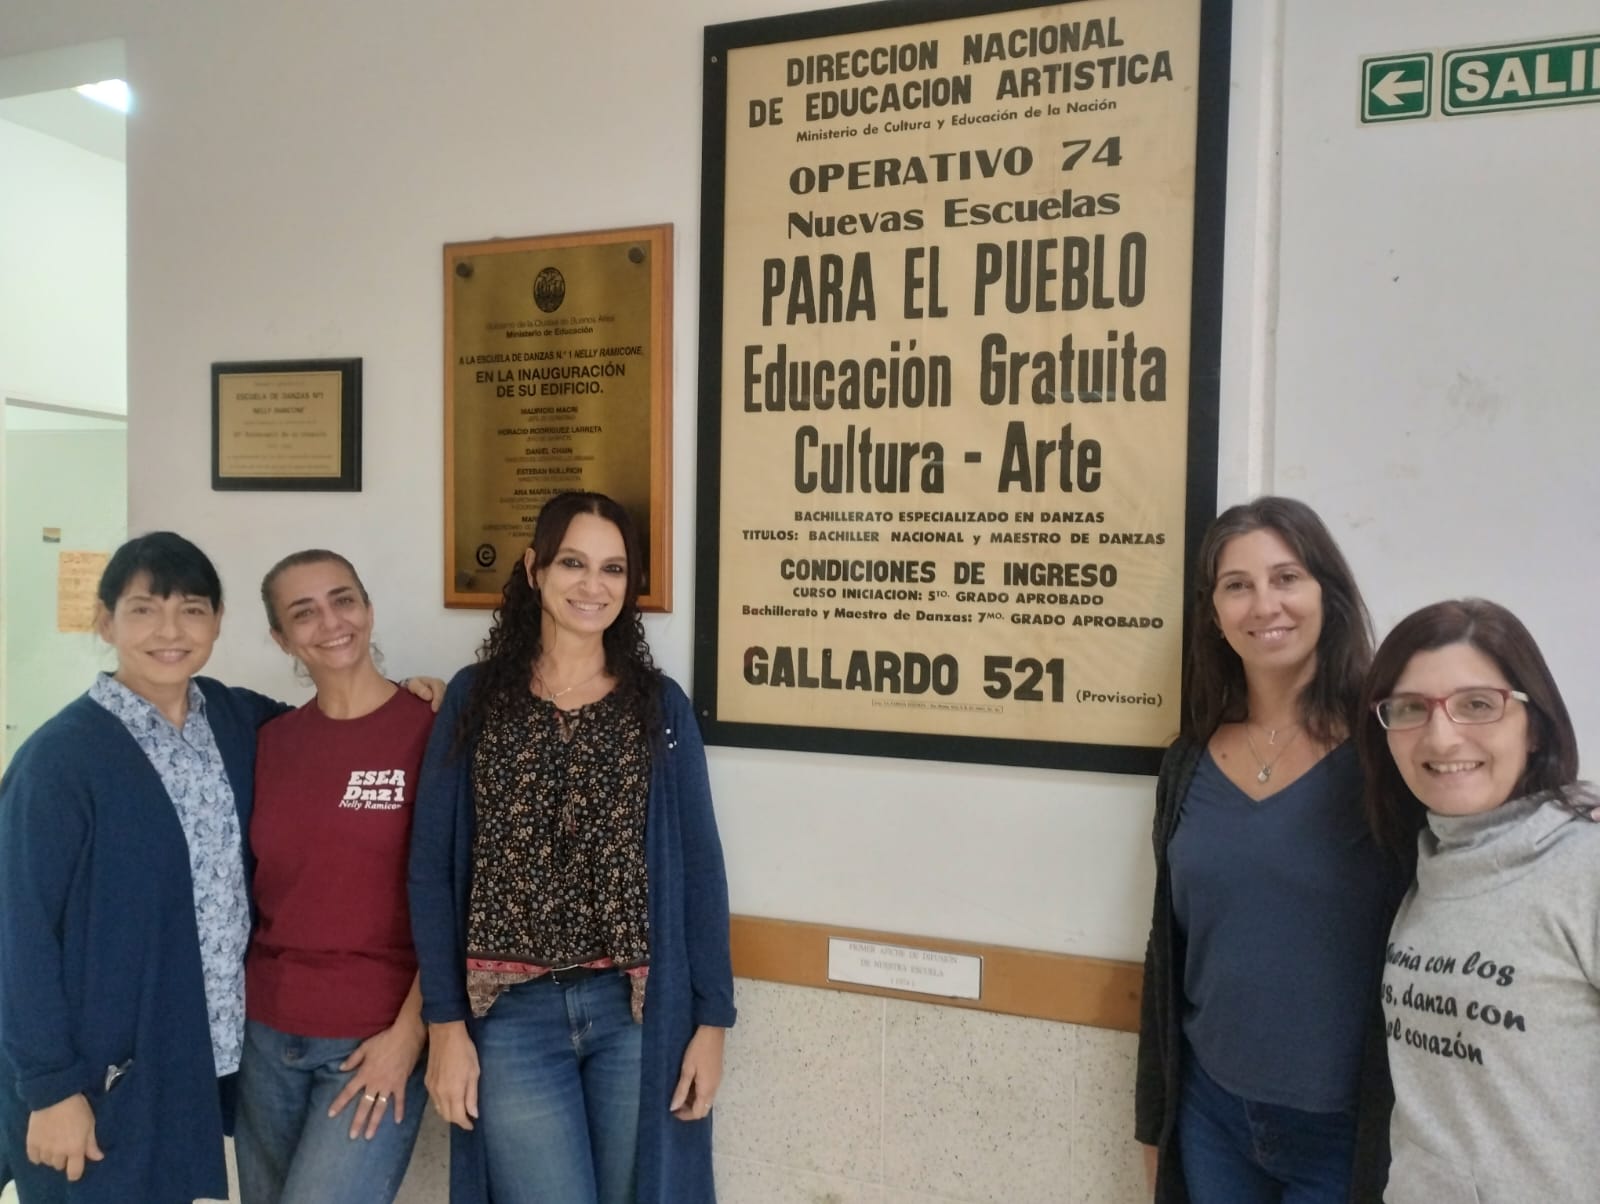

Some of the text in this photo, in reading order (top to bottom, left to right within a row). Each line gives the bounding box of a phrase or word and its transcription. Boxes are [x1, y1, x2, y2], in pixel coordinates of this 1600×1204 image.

[786, 17, 1124, 87] DIRECCION NACIONAL
[748, 51, 1173, 128] DE EDUCACION ARTISTICA
[1455, 48, 1600, 102] SALI
[796, 99, 1118, 143] Ministerio de Cultura y Educación de la Nación
[789, 136, 1123, 195] OPERATIVO 74
[788, 189, 1121, 239] Nuevas Escuelas
[762, 231, 1147, 326] PARA EL PUEBLO
[544, 329, 553, 337] de
[476, 362, 626, 383] EN LA INAUGURACIÓN
[512, 352, 522, 362] DE
[574, 348, 598, 359] NELLY
[744, 330, 1167, 412] Educación Gratuita
[496, 381, 604, 398] DE SU EDIFICIO.
[795, 421, 1101, 493] Cultura - Arte
[795, 511, 1105, 523] BACHILLERATO ESPECIALIZADO EN DANZAS
[742, 530, 1166, 546] TITULOS: BACHILLER NACIONAL y MAESTRO DE DANZAS
[780, 558, 1118, 588] CONDICIONES DE INGRESO
[793, 587, 837, 599] CURSO
[842, 588, 923, 601] INICIACION:
[956, 591, 1009, 603] GRADO
[1015, 592, 1104, 605] APROBADO
[742, 605, 818, 618] Bachillerato
[823, 609, 830, 620] y
[834, 607, 888, 620] Maestro
[893, 609, 911, 621] de
[916, 610, 972, 623] Danzas:
[1011, 613, 1066, 626] GRADO
[1072, 615, 1164, 629] APROBADO
[743, 646, 1163, 708] GALLARDO 521 (Provisoria)
[348, 769, 406, 787] ESEA
[338, 800, 362, 811] Nelly
[1425, 956, 1456, 975] con
[1462, 951, 1515, 987] los
[1402, 983, 1458, 1017] danza
[1466, 1001, 1526, 1032] con
